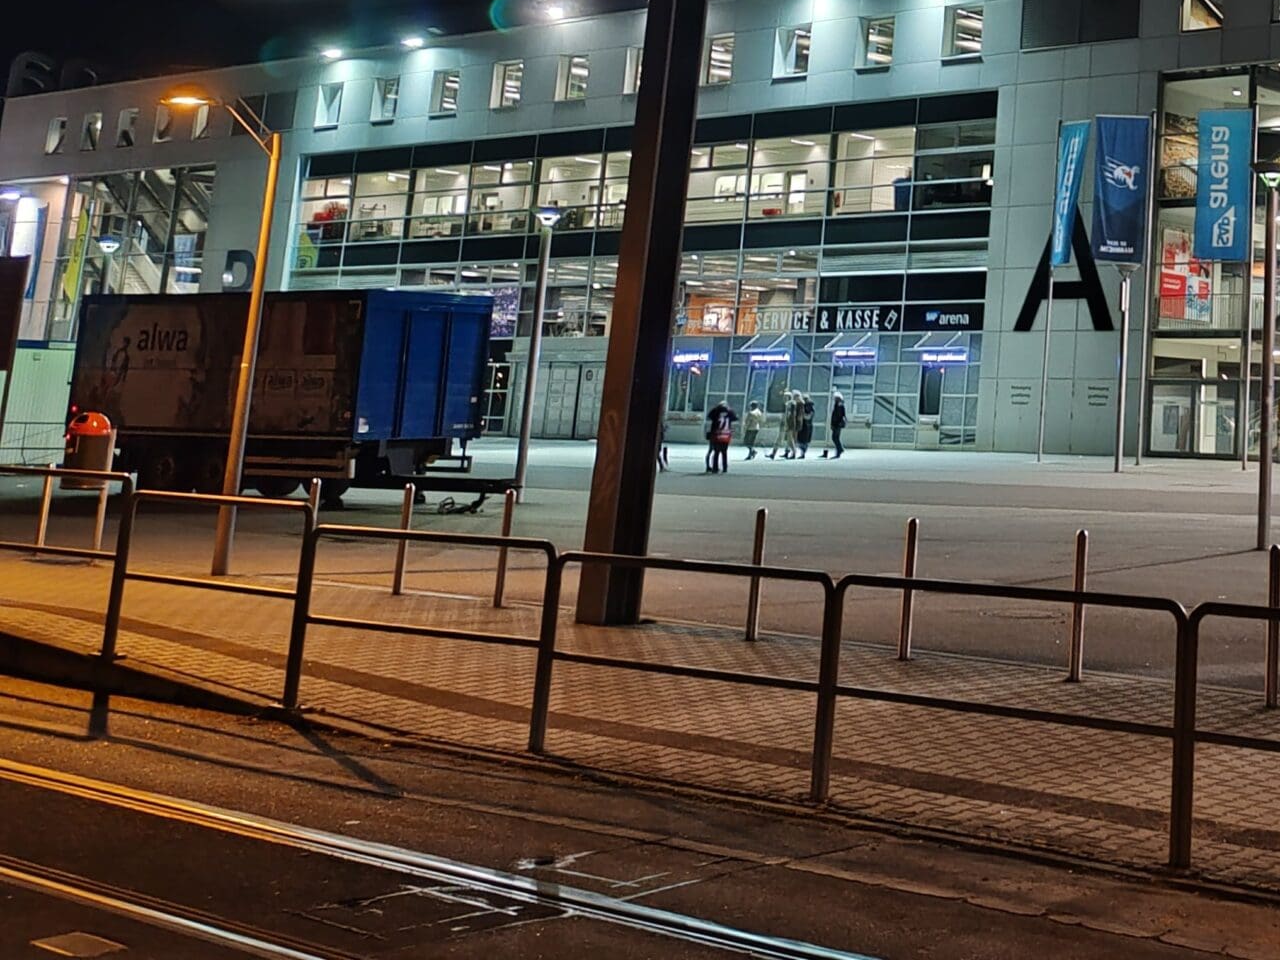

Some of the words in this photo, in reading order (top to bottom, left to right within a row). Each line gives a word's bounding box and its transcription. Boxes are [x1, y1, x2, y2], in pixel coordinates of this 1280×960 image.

[222, 250, 256, 292] D
[1013, 202, 1115, 332] A
[756, 311, 810, 330] SERVICE
[820, 310, 829, 330] &
[836, 310, 880, 329] KASSE
[939, 313, 969, 325] arena
[137, 323, 188, 351] alwa
